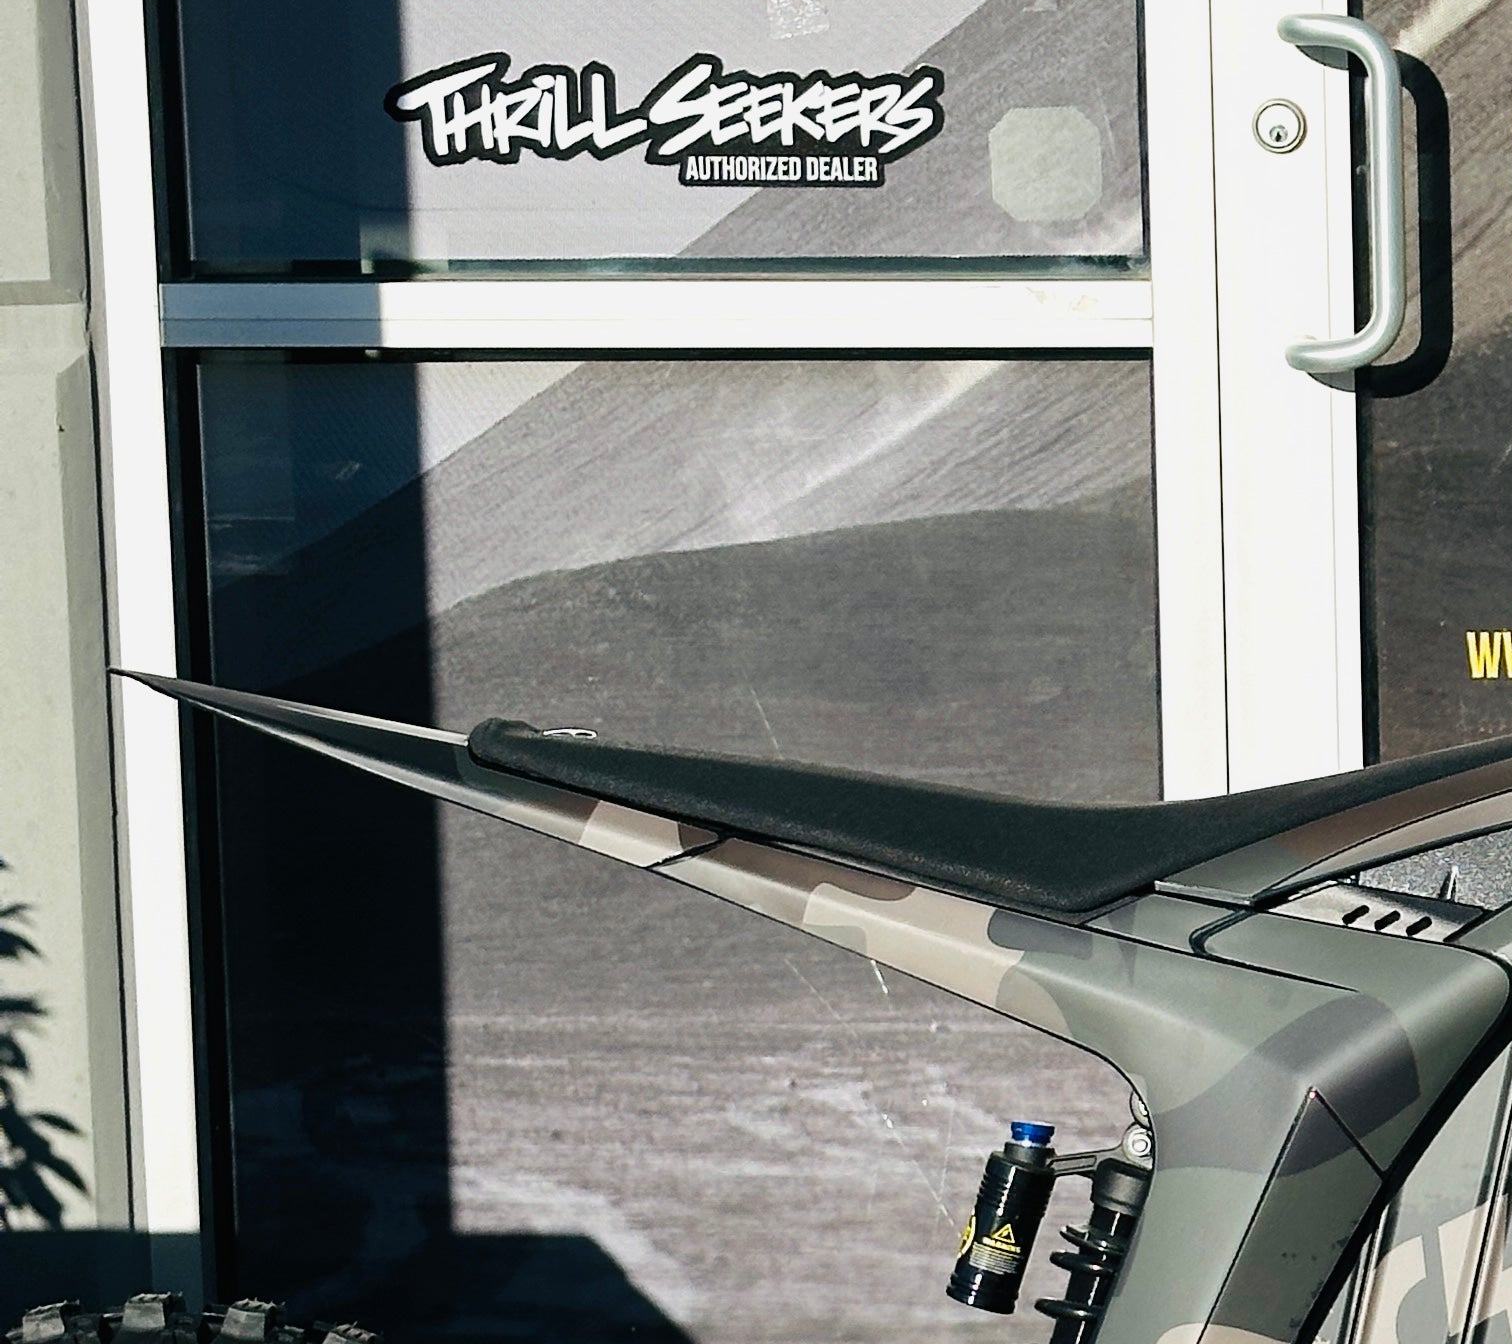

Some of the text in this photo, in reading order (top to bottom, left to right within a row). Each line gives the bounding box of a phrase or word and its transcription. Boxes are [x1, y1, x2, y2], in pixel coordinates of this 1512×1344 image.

[650, 63, 935, 157] SEEKERS
[686, 156, 878, 183] AUTHORIZED DEALER
